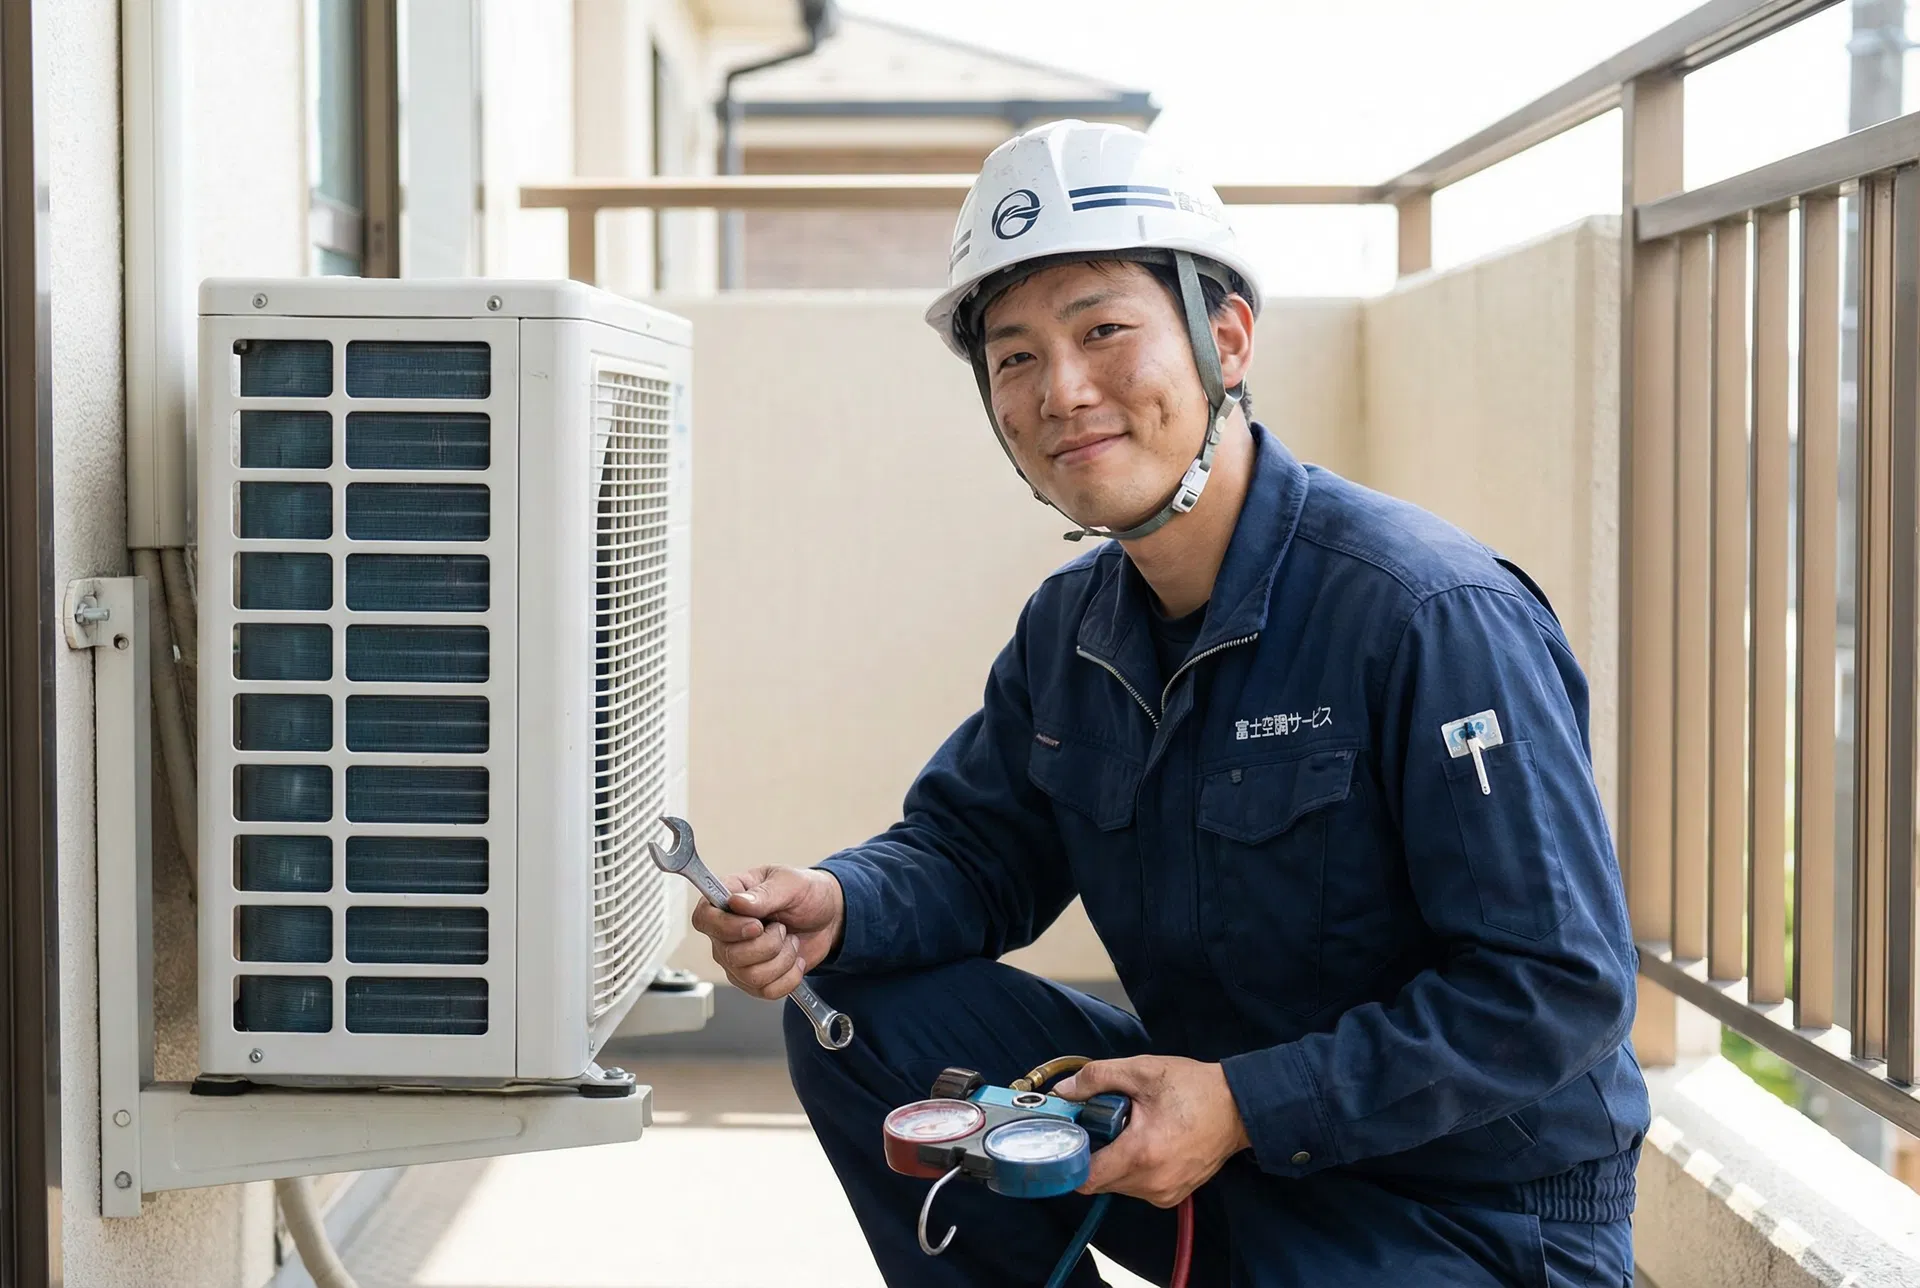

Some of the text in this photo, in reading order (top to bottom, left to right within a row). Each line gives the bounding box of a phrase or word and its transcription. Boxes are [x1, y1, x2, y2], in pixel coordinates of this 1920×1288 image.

[1235, 706, 1332, 740] 富士空調サービス
